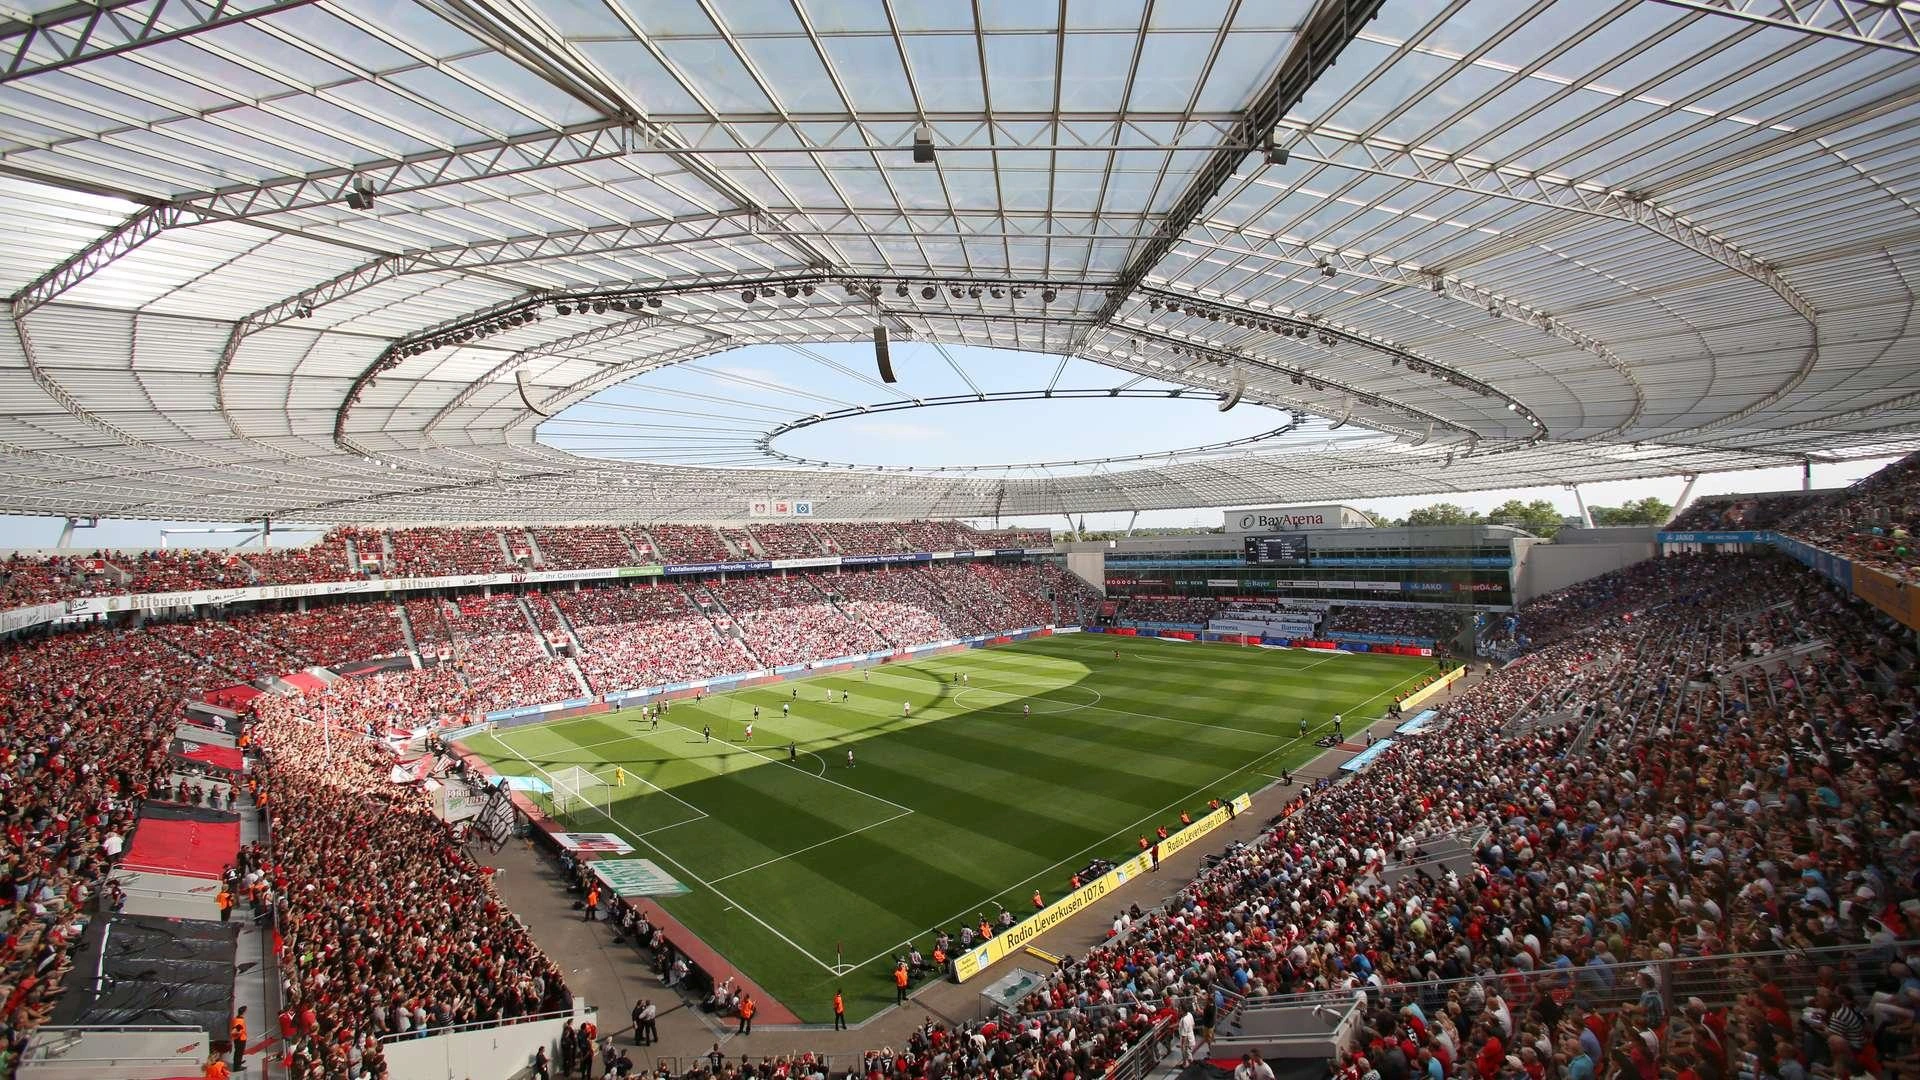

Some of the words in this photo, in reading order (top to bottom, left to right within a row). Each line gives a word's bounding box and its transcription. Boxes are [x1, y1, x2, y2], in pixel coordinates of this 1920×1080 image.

[1259, 514, 1323, 527] BayArena
[400, 580, 449, 589] Bitburger
[1460, 584, 1502, 592] bayer04.de
[273, 586, 317, 597] Bitburger
[130, 594, 193, 608] Bitburger
[1167, 835, 1184, 852] Radio
[1183, 818, 1215, 843] Leverkusen
[1006, 926, 1033, 948] Radio
[1035, 896, 1082, 931] Leverkusen
[1083, 881, 1105, 904] 107.6
